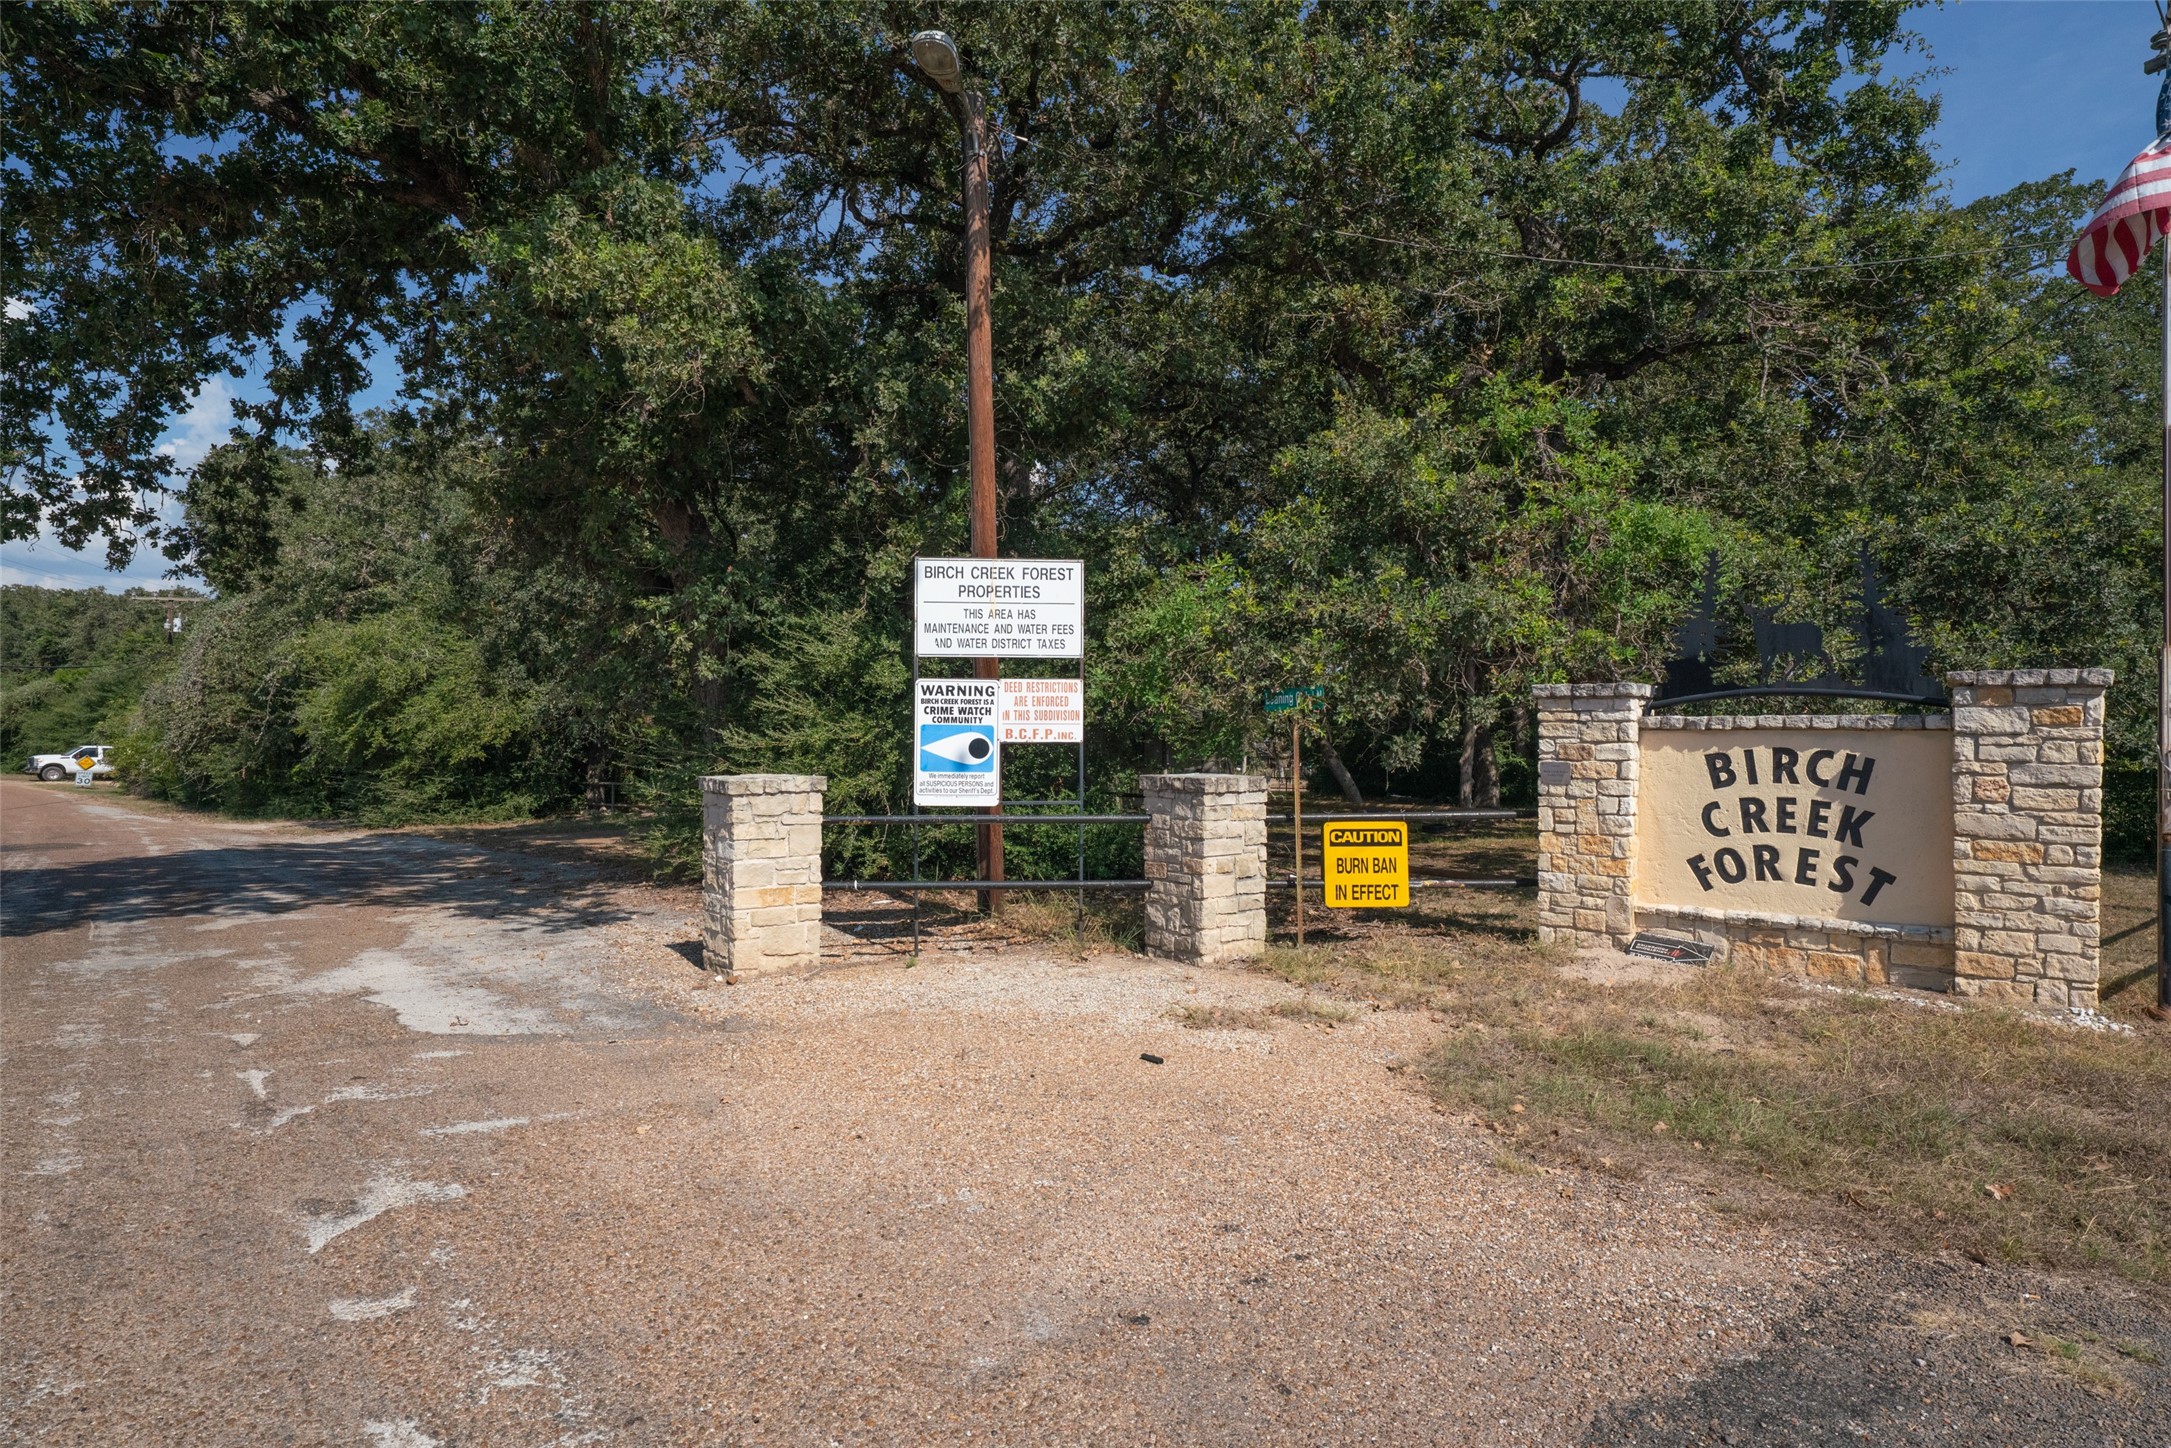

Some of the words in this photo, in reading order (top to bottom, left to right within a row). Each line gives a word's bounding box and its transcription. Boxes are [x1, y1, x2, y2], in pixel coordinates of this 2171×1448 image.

[925, 566, 964, 579] BIRCH
[971, 566, 1015, 580] CREEK
[1022, 567, 1074, 581] FOREST
[958, 585, 1041, 599] PROPERTIES
[963, 609, 983, 619] THIS
[988, 609, 1013, 619] AREA
[1017, 609, 1036, 620] HAS
[924, 623, 989, 634] MAINTENANCE
[994, 623, 1013, 634] AND
[1017, 624, 1047, 635] WATER
[1052, 624, 1075, 635] FEES
[935, 638, 952, 648] AND
[957, 638, 987, 649] WATER
[991, 638, 1032, 649] DISTRICT
[1037, 639, 1066, 650] TAXES
[921, 684, 995, 697] WARNING
[1004, 681, 1023, 693] DEED
[1026, 681, 1079, 694] RESTRICTIONS
[1014, 695, 1030, 707] ARE
[1032, 695, 1069, 707] ENFORCED
[924, 706, 954, 716] CRIME
[957, 706, 991, 716] WATCH
[1002, 710, 1010, 721] IN
[1013, 710, 1030, 721] THIS
[1034, 710, 1080, 721] SUBDIVISION
[932, 716, 983, 724] COMMUNITY
[1704, 747, 1876, 795] BIRCH
[1701, 797, 1875, 848] CREEK
[1330, 830, 1401, 843] CAUTION
[1336, 857, 1369, 874] BURN
[1373, 857, 1397, 874] BAN
[1686, 844, 1897, 907] FOREST
[1336, 884, 1347, 900] IN
[1352, 884, 1399, 900] EFFECT
